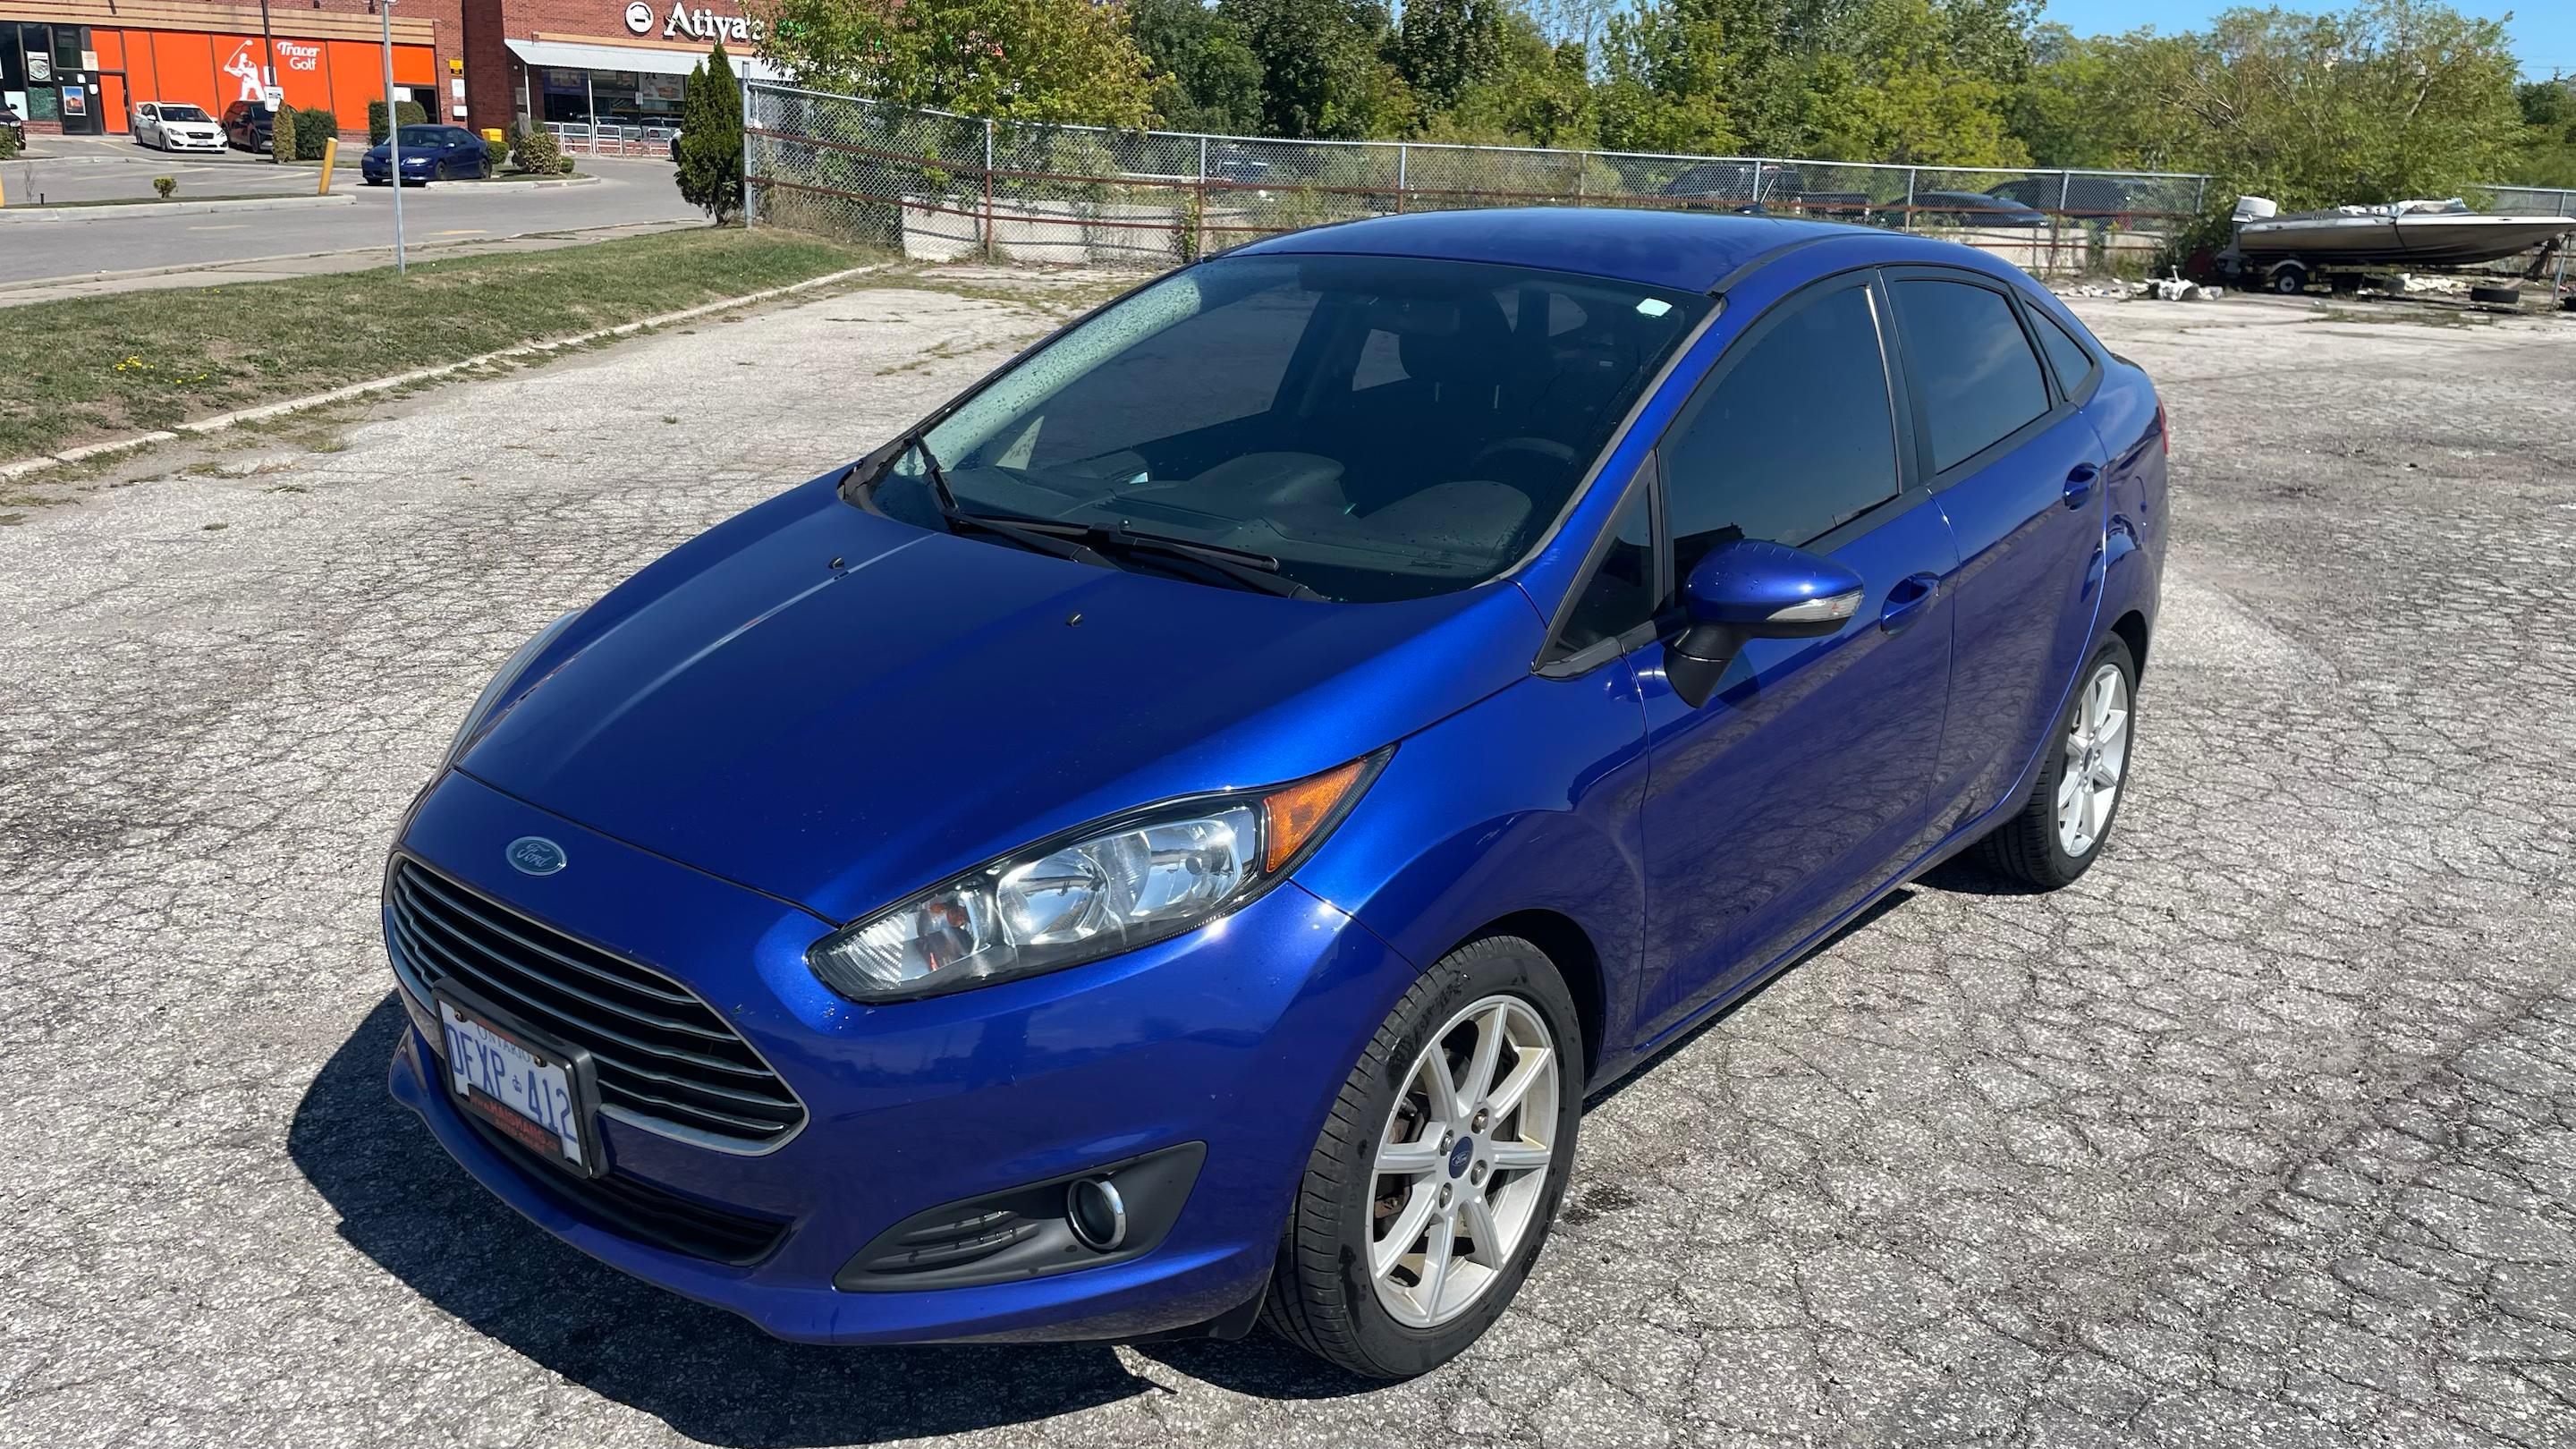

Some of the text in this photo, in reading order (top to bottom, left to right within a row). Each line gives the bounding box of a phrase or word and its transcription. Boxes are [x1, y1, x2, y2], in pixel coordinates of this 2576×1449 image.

[663, 1, 765, 44] Atiya's
[276, 41, 320, 57] Tracer
[290, 56, 317, 71] Golf
[516, 843, 554, 868] Ford
[444, 1021, 506, 1100] DFXP
[527, 1069, 578, 1144] 412
